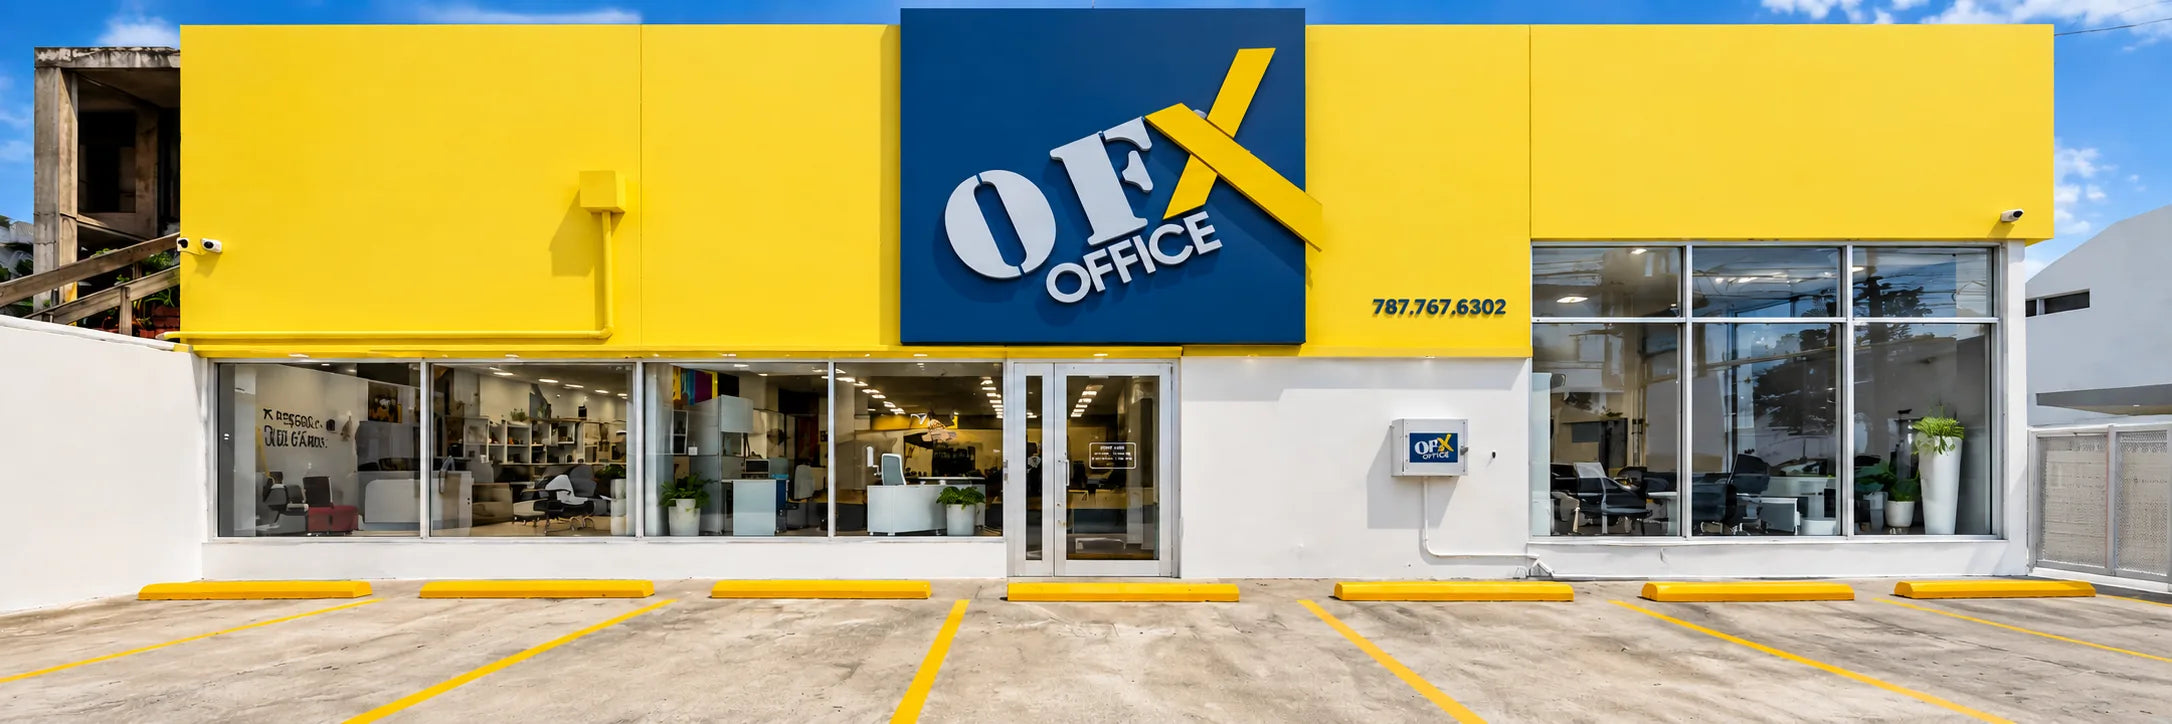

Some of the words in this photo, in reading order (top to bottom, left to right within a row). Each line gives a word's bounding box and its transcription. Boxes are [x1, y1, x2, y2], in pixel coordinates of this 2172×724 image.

[945, 47, 1322, 279] OFX
[1046, 211, 1223, 303] OFFICE
[1372, 298, 1507, 315] 787.767.6302
